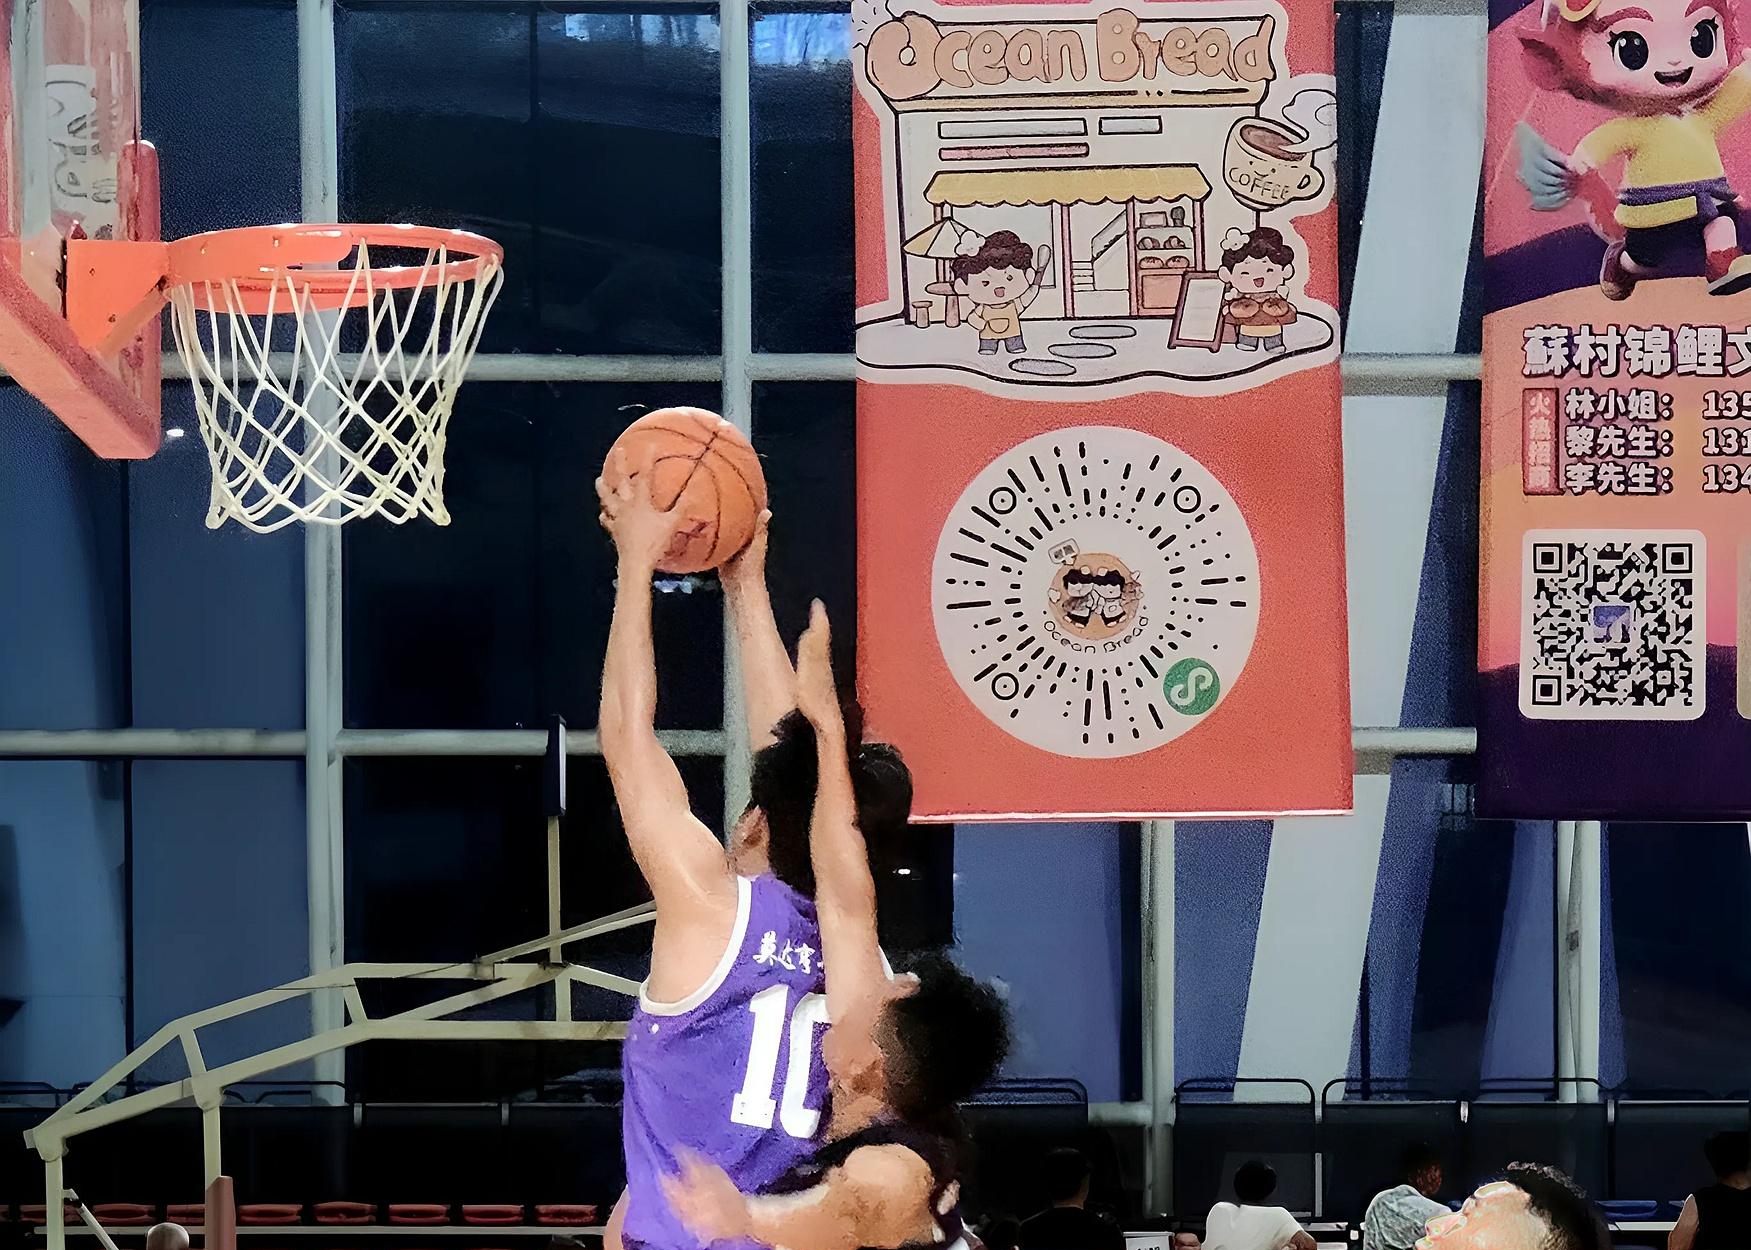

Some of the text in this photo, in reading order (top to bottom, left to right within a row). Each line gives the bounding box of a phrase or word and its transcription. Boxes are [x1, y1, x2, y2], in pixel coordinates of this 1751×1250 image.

[866, 8, 1276, 99] Ocean Bread
[1228, 166, 1290, 200] COFFEE
[1043, 615, 1149, 654] Ocean Bread
